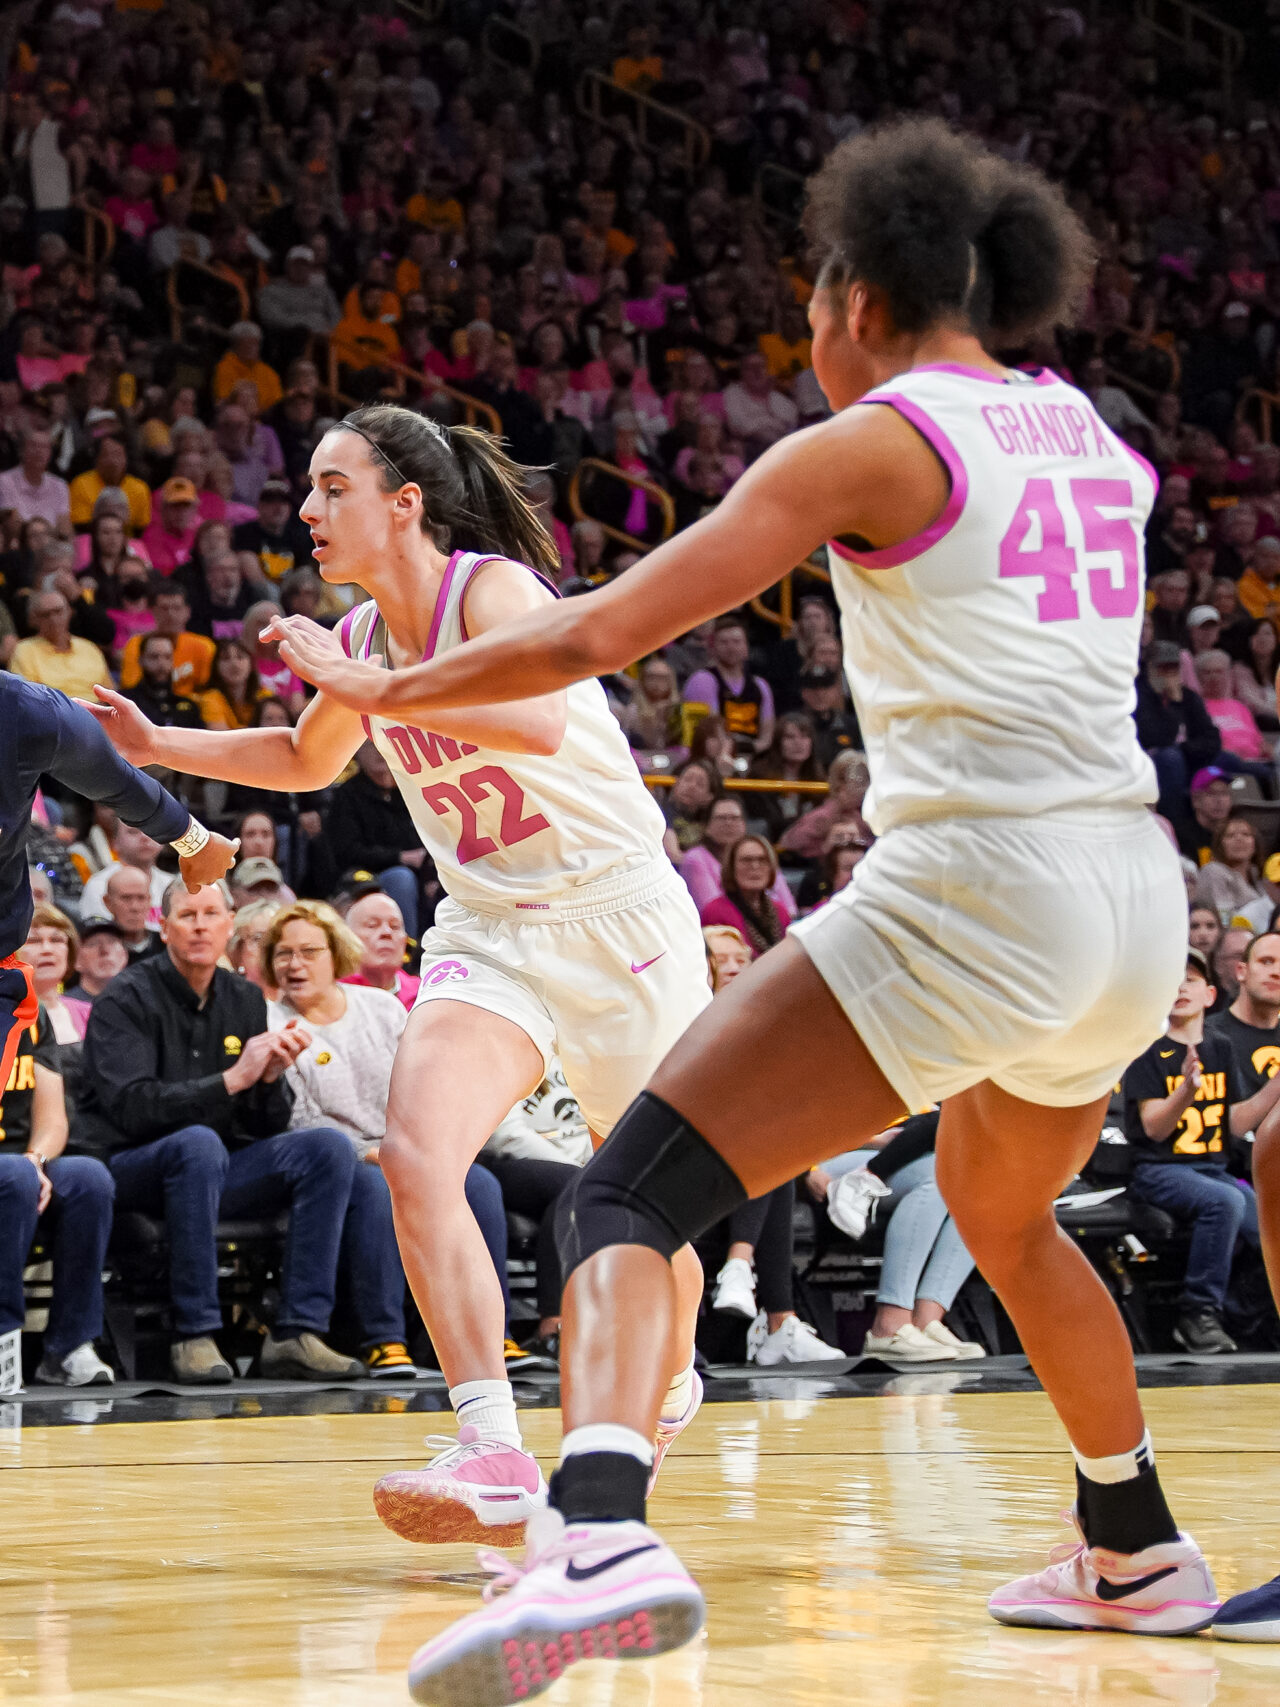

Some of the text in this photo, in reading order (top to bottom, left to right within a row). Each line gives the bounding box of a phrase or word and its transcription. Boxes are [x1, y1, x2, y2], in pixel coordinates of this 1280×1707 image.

[998, 478, 1140, 623] 45
[381, 725, 479, 774] OW
[421, 765, 551, 865] 22
